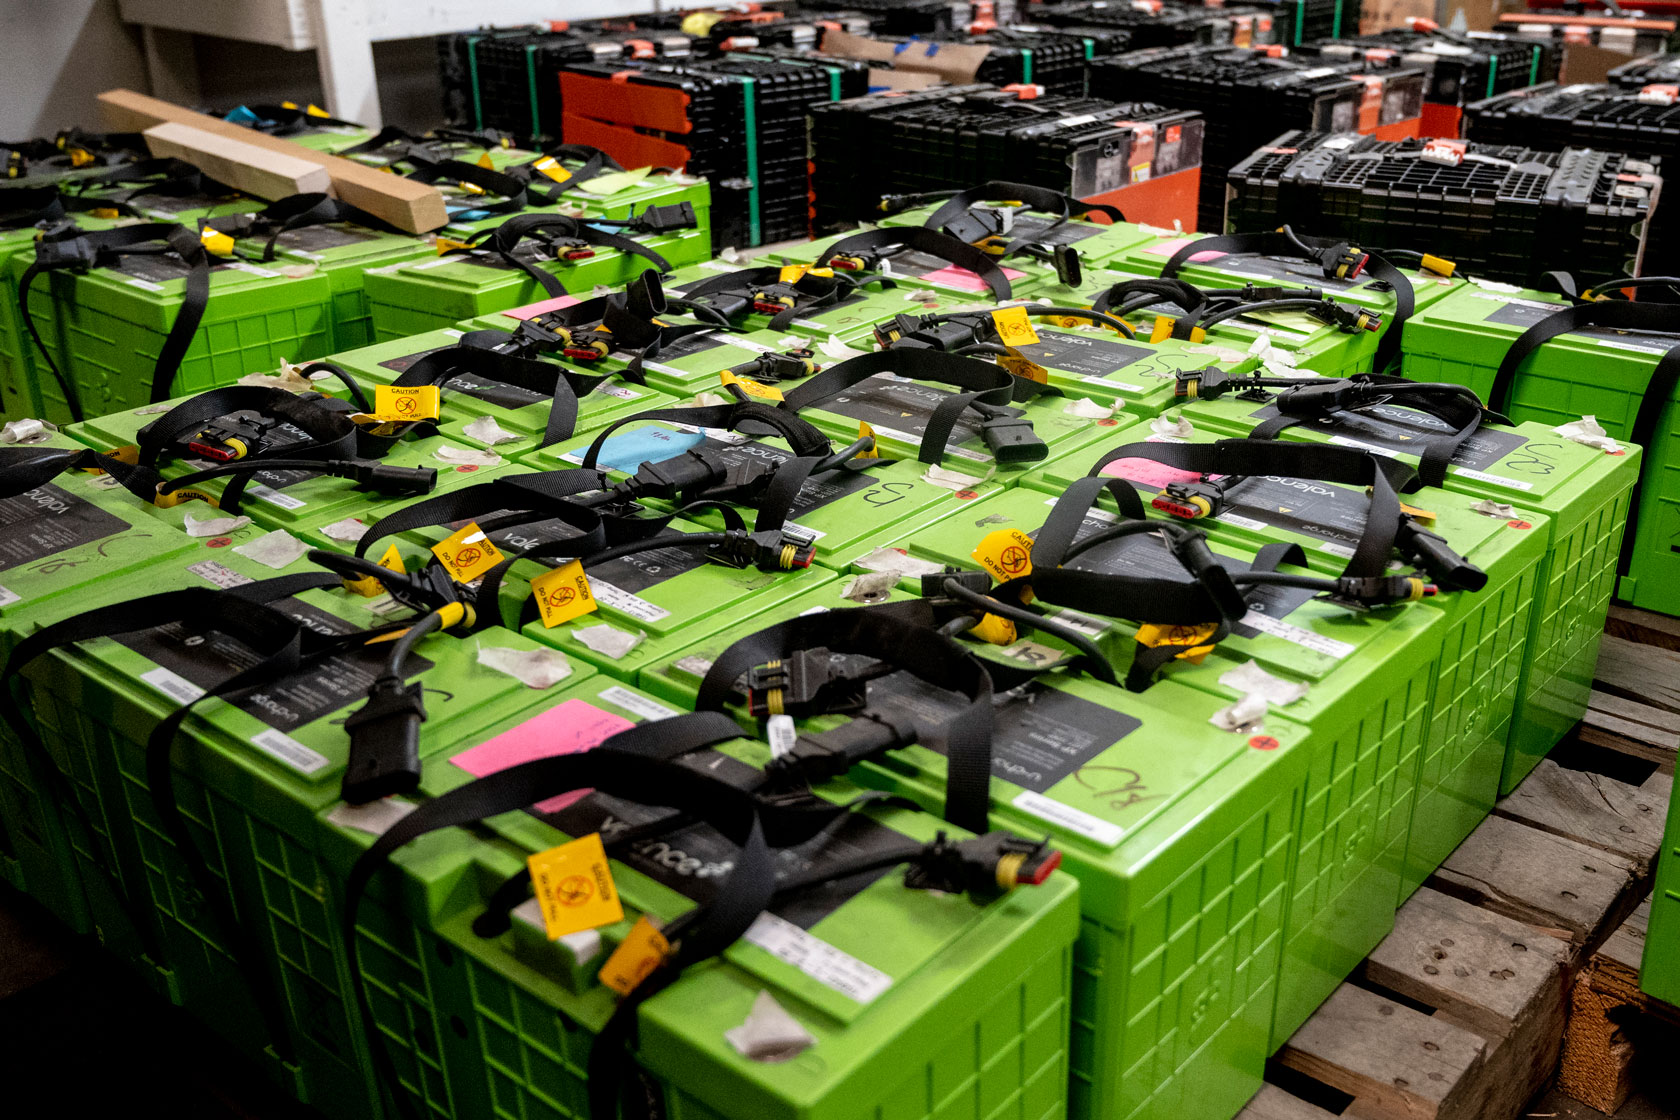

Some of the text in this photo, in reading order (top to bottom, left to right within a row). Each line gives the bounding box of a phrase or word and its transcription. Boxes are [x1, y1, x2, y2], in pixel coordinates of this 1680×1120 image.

[1372, 406, 1449, 430] valence
[177, 492, 209, 503] CAUTION
[478, 539, 496, 557] AUTION
[503, 532, 541, 551] vale
[442, 551, 464, 578] DO NOT PULL
[983, 556, 994, 567] DO
[993, 563, 1010, 577] NOT
[575, 575, 590, 600] CAUTION
[538, 586, 554, 620] DO NOT PULL
[250, 692, 300, 721] u-charge
